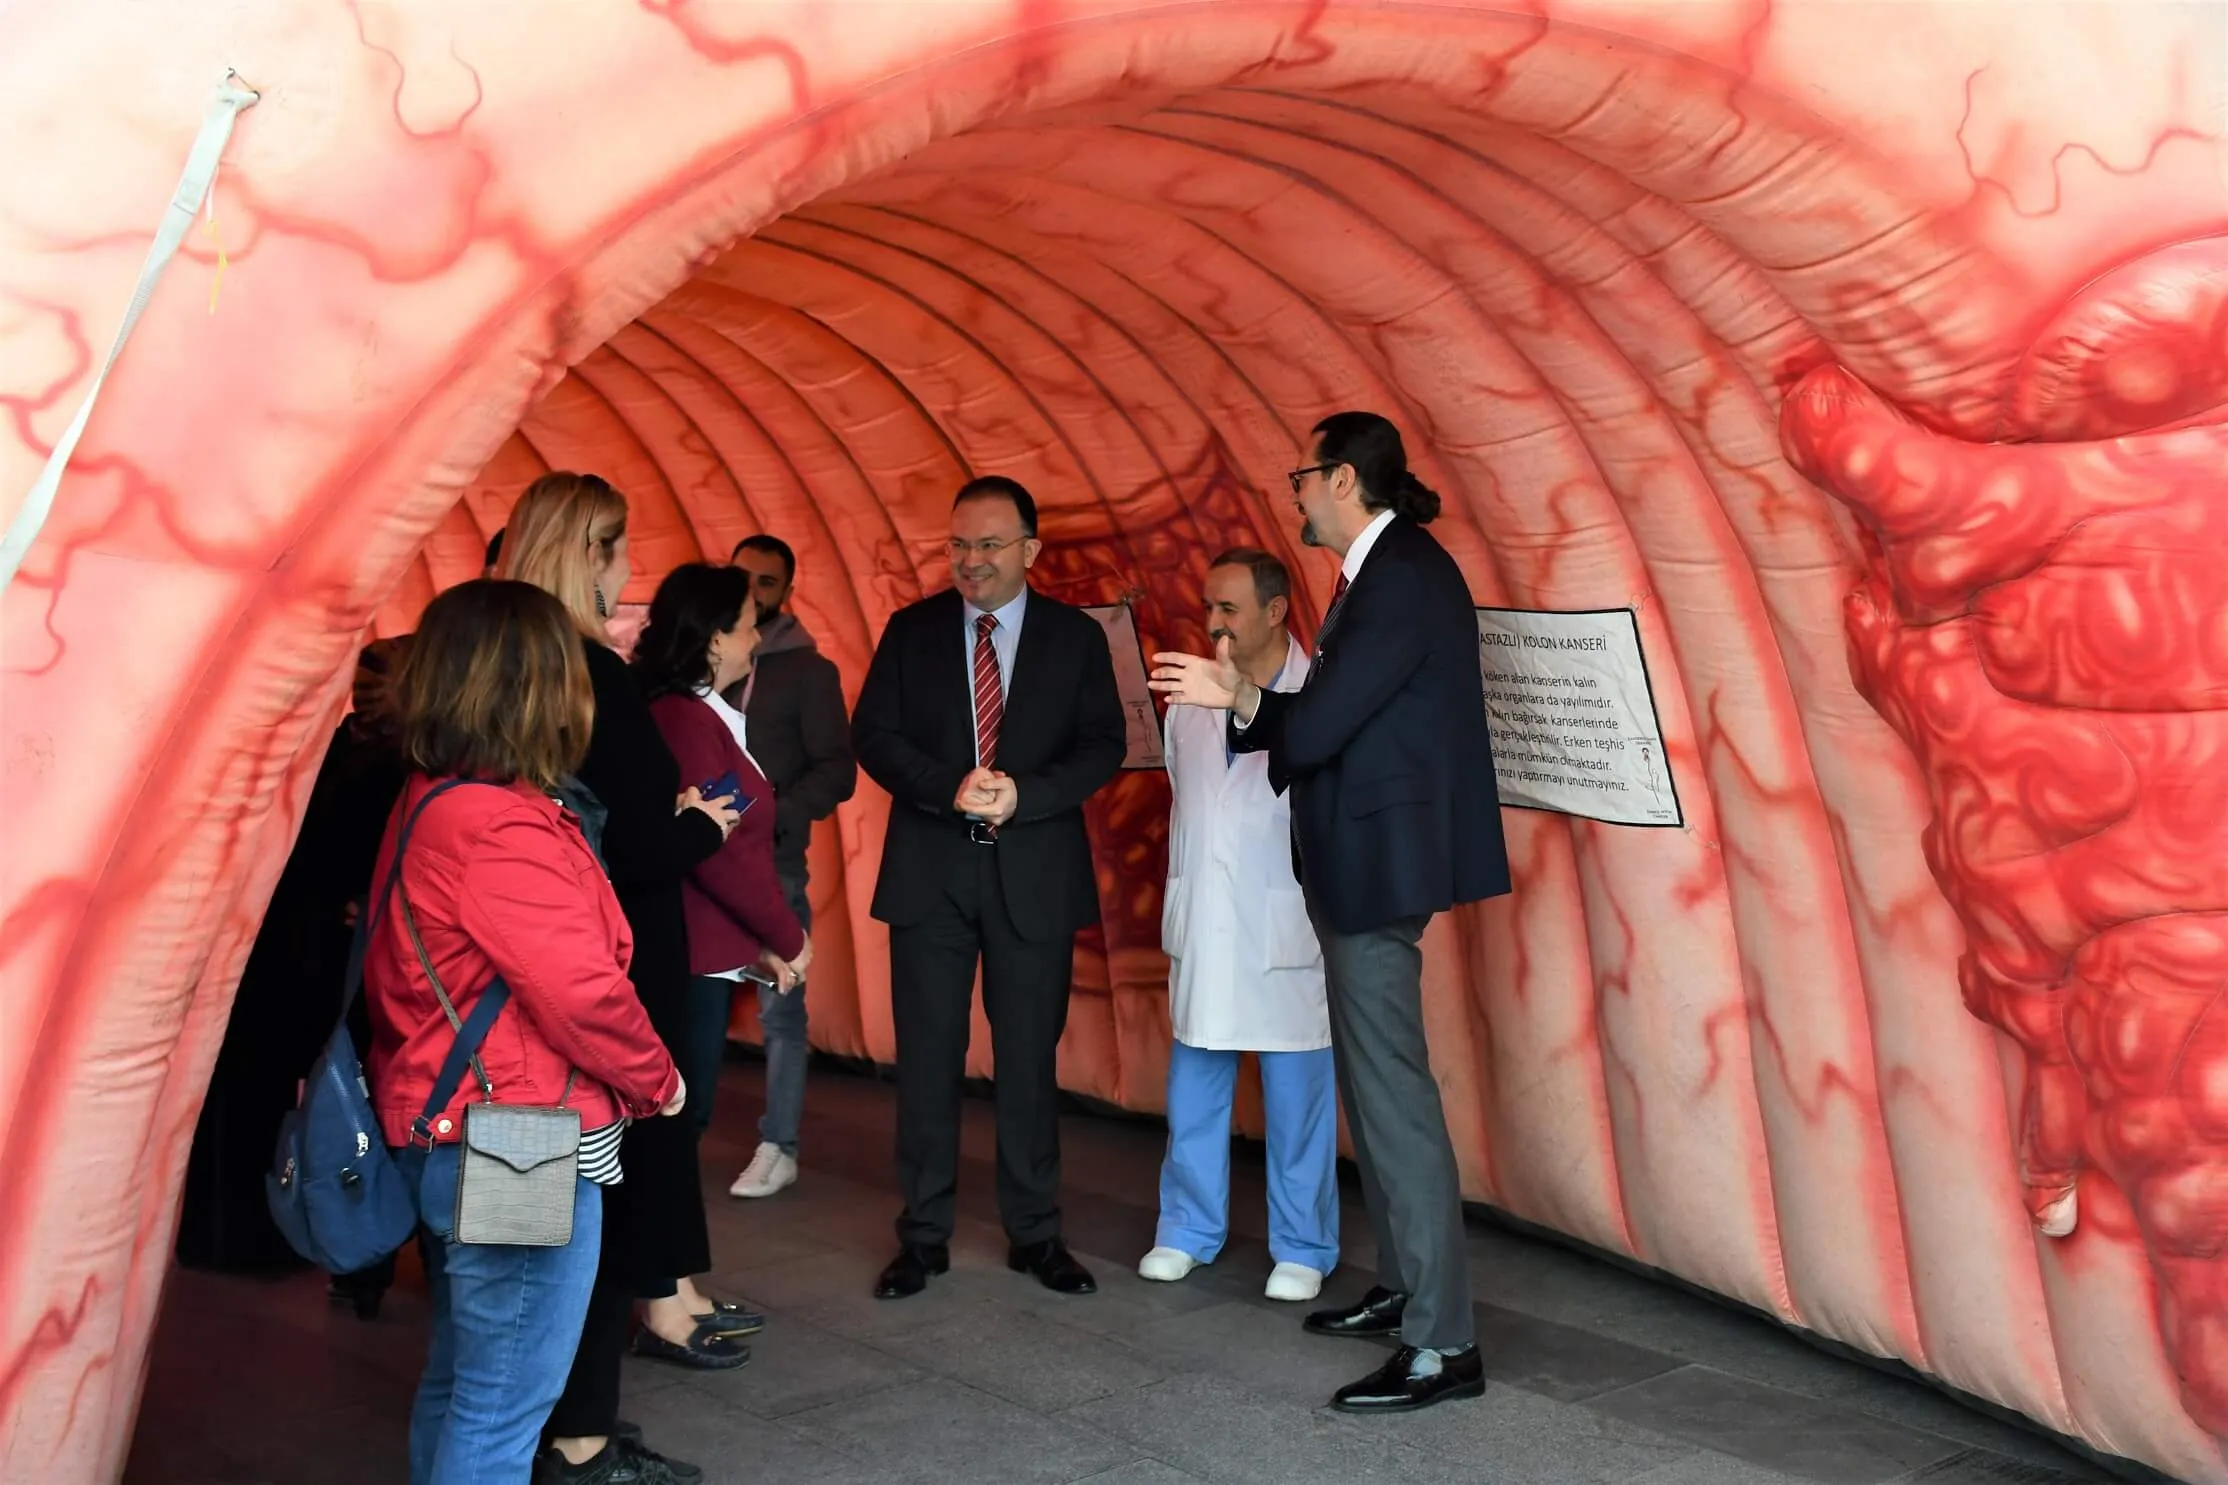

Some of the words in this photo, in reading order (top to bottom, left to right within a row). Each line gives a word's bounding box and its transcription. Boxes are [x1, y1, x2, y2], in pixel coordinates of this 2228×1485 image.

[1480, 633, 1520, 649] ASTAZLI)
[1523, 635, 1557, 649] KOLON
[1559, 635, 1607, 651] KANSERİ
[1511, 673, 1530, 684] alan
[1531, 674, 1571, 687] kanserin
[1573, 676, 1597, 688] kalın
[1483, 689, 1502, 702] aşka
[1503, 692, 1545, 705] organlara
[1547, 694, 1559, 705] da
[1560, 696, 1614, 709] yayılımıdır.
[1512, 711, 1547, 725] bağırsak
[1551, 713, 1619, 729] kanserlerinde
[1563, 735, 1592, 748] Erken
[1594, 737, 1625, 752] teşhis
[1491, 748, 1516, 760] alarla
[1518, 751, 1559, 764] mümkün
[1517, 769, 1565, 786] yaptırmayı
[1567, 776, 1630, 792] unutmayınız.
